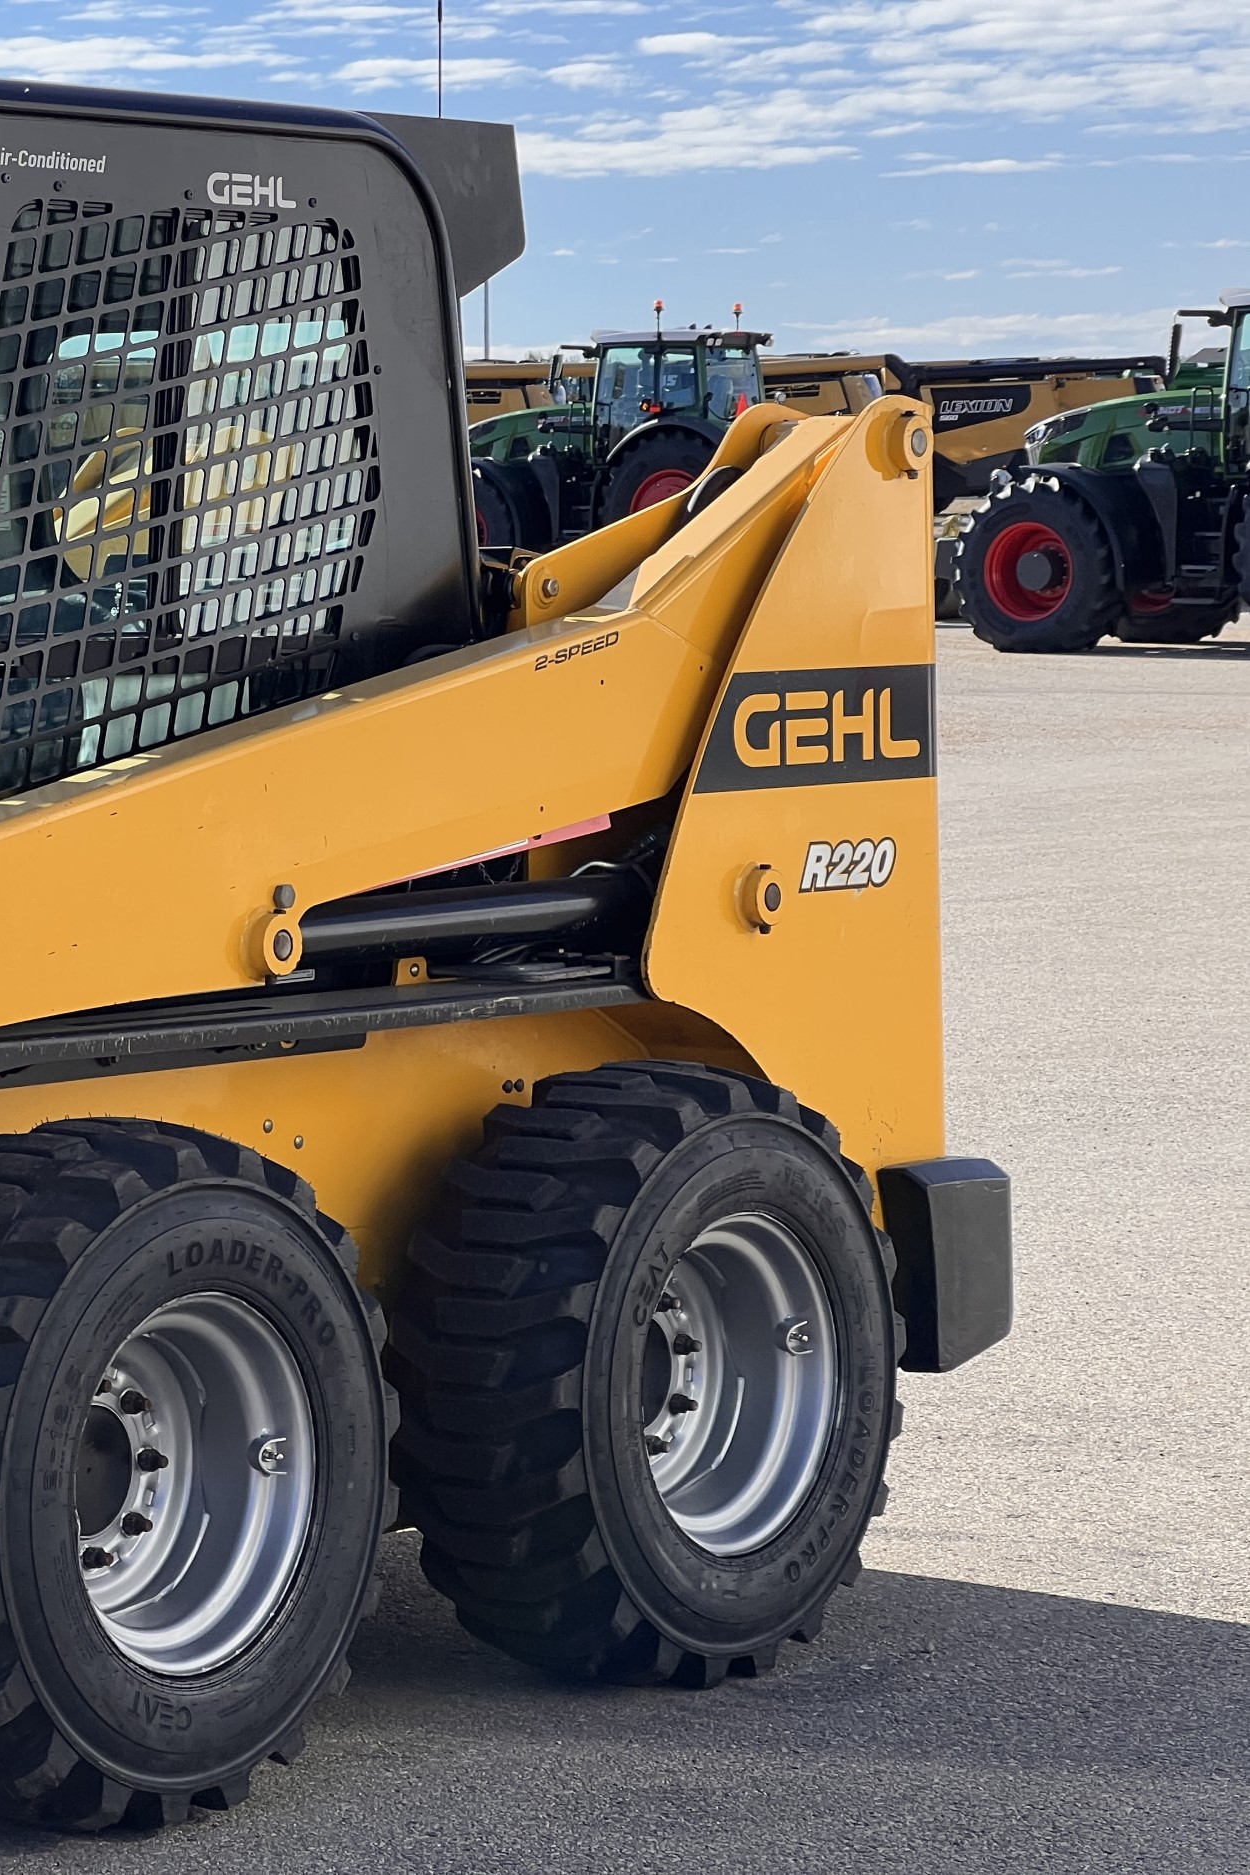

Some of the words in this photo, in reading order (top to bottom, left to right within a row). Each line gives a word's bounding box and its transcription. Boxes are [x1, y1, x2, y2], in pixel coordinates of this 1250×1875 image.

[207, 172, 296, 208] GEHL
[939, 398, 1014, 414] LEXION
[534, 630, 620, 672] 2-SPEED
[733, 687, 921, 768] GEHL
[799, 837, 897, 894] R220
[165, 1239, 336, 1347] LOADER-PRO
[632, 1241, 669, 1328] CEAT
[784, 1362, 877, 1585] LOADER-PRO
[127, 1687, 193, 1731] CEAT
